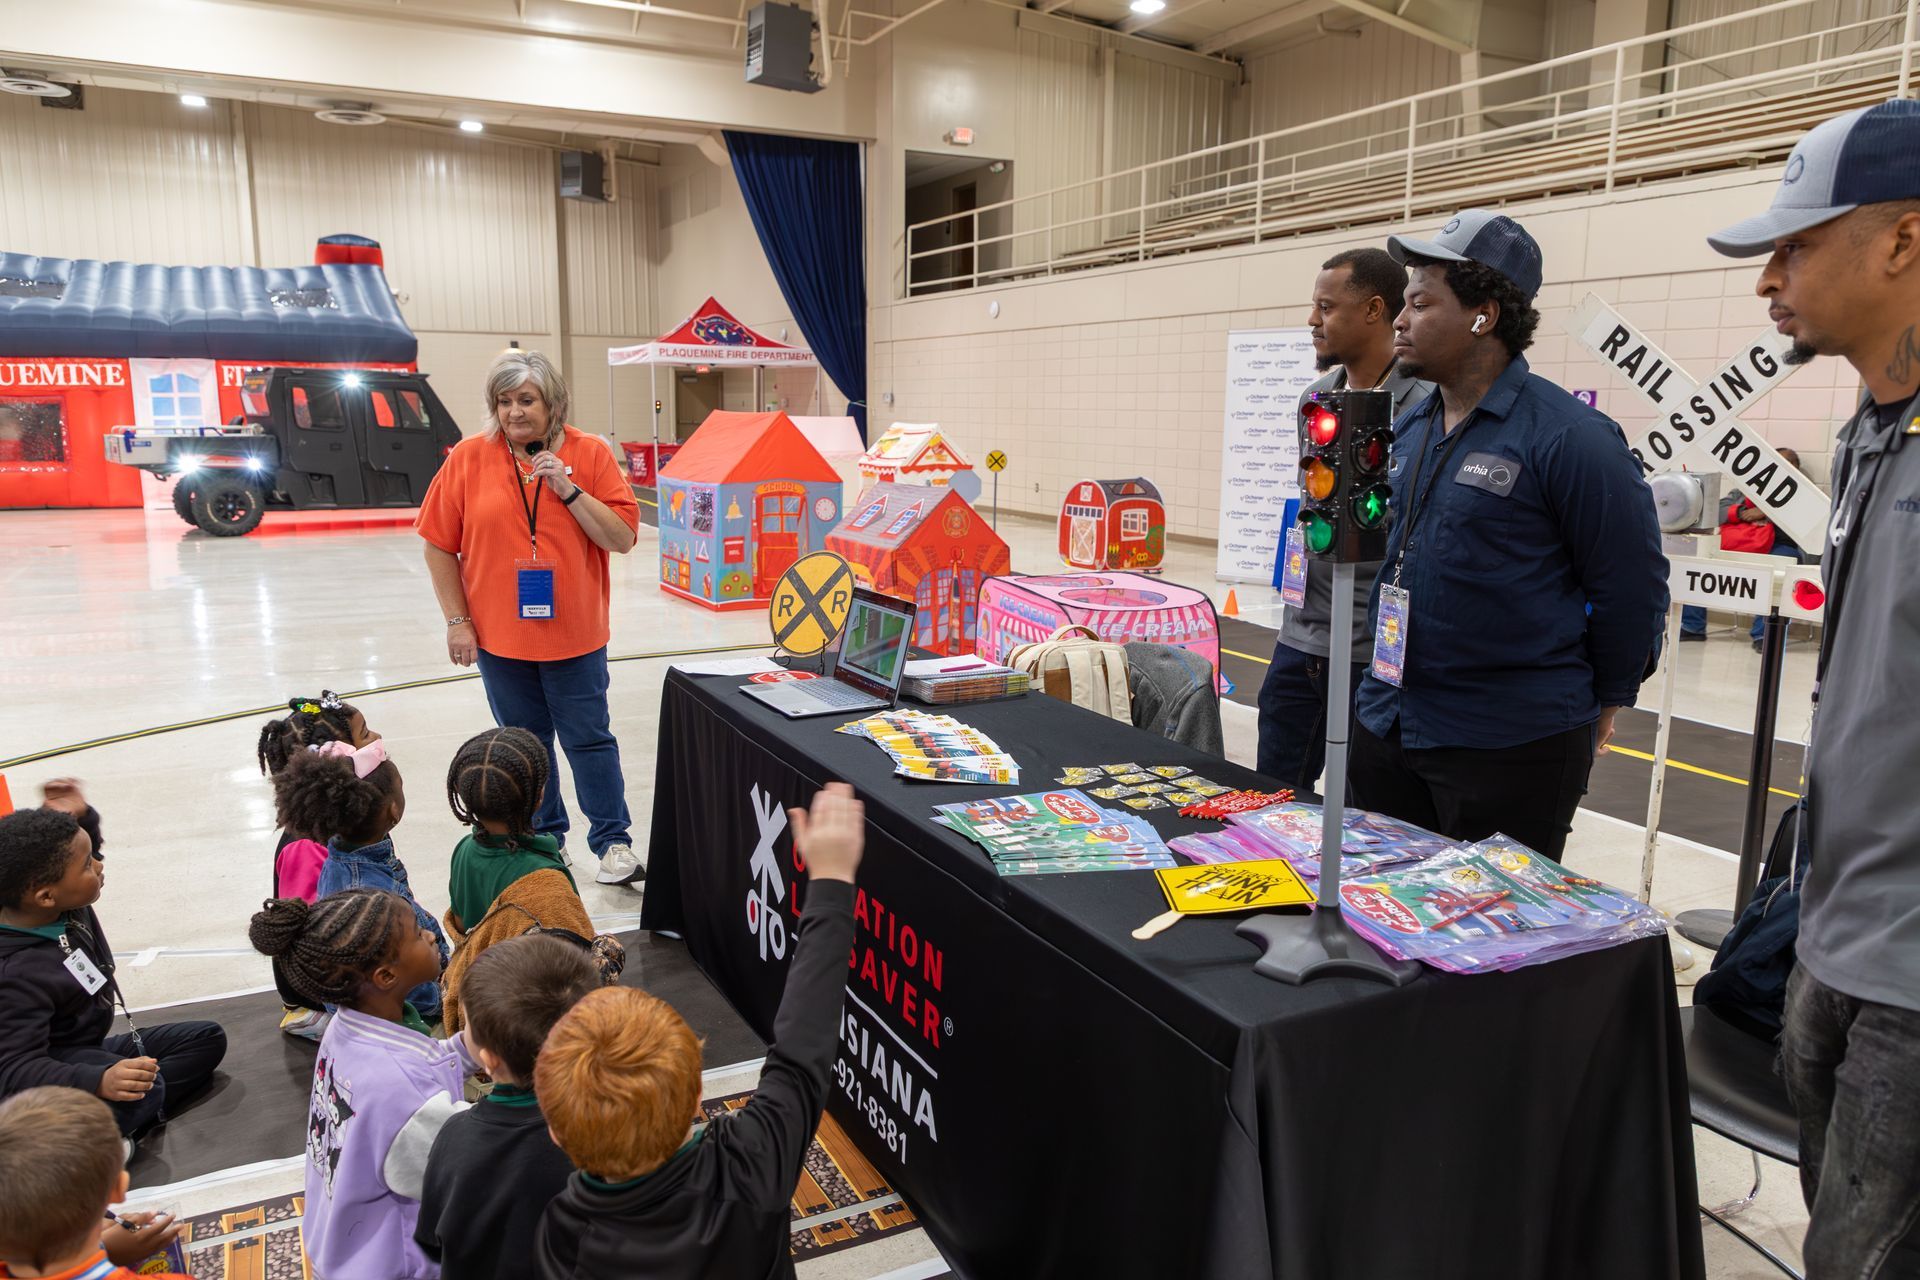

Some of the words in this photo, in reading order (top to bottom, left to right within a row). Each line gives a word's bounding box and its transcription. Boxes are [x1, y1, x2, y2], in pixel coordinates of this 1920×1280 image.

[659, 347, 724, 359] PLAQUEMINE
[726, 349, 748, 360] FIRE
[750, 351, 814, 361] DEPARTMENT
[222, 365, 244, 387] FI
[1600, 324, 1672, 403] RAIL
[1711, 427, 1798, 508] ROAD
[1630, 346, 1779, 478] ROSSING
[1463, 464, 1488, 476] orbia
[764, 482, 798, 491] SCHOOL
[1686, 570, 1757, 599] TOWN
[778, 594, 795, 617] R
[831, 590, 848, 614] R
[999, 594, 1057, 628] ICE-CREAM
[1092, 618, 1205, 637] ICE-CREAM
[1195, 870, 1279, 894] THINK
